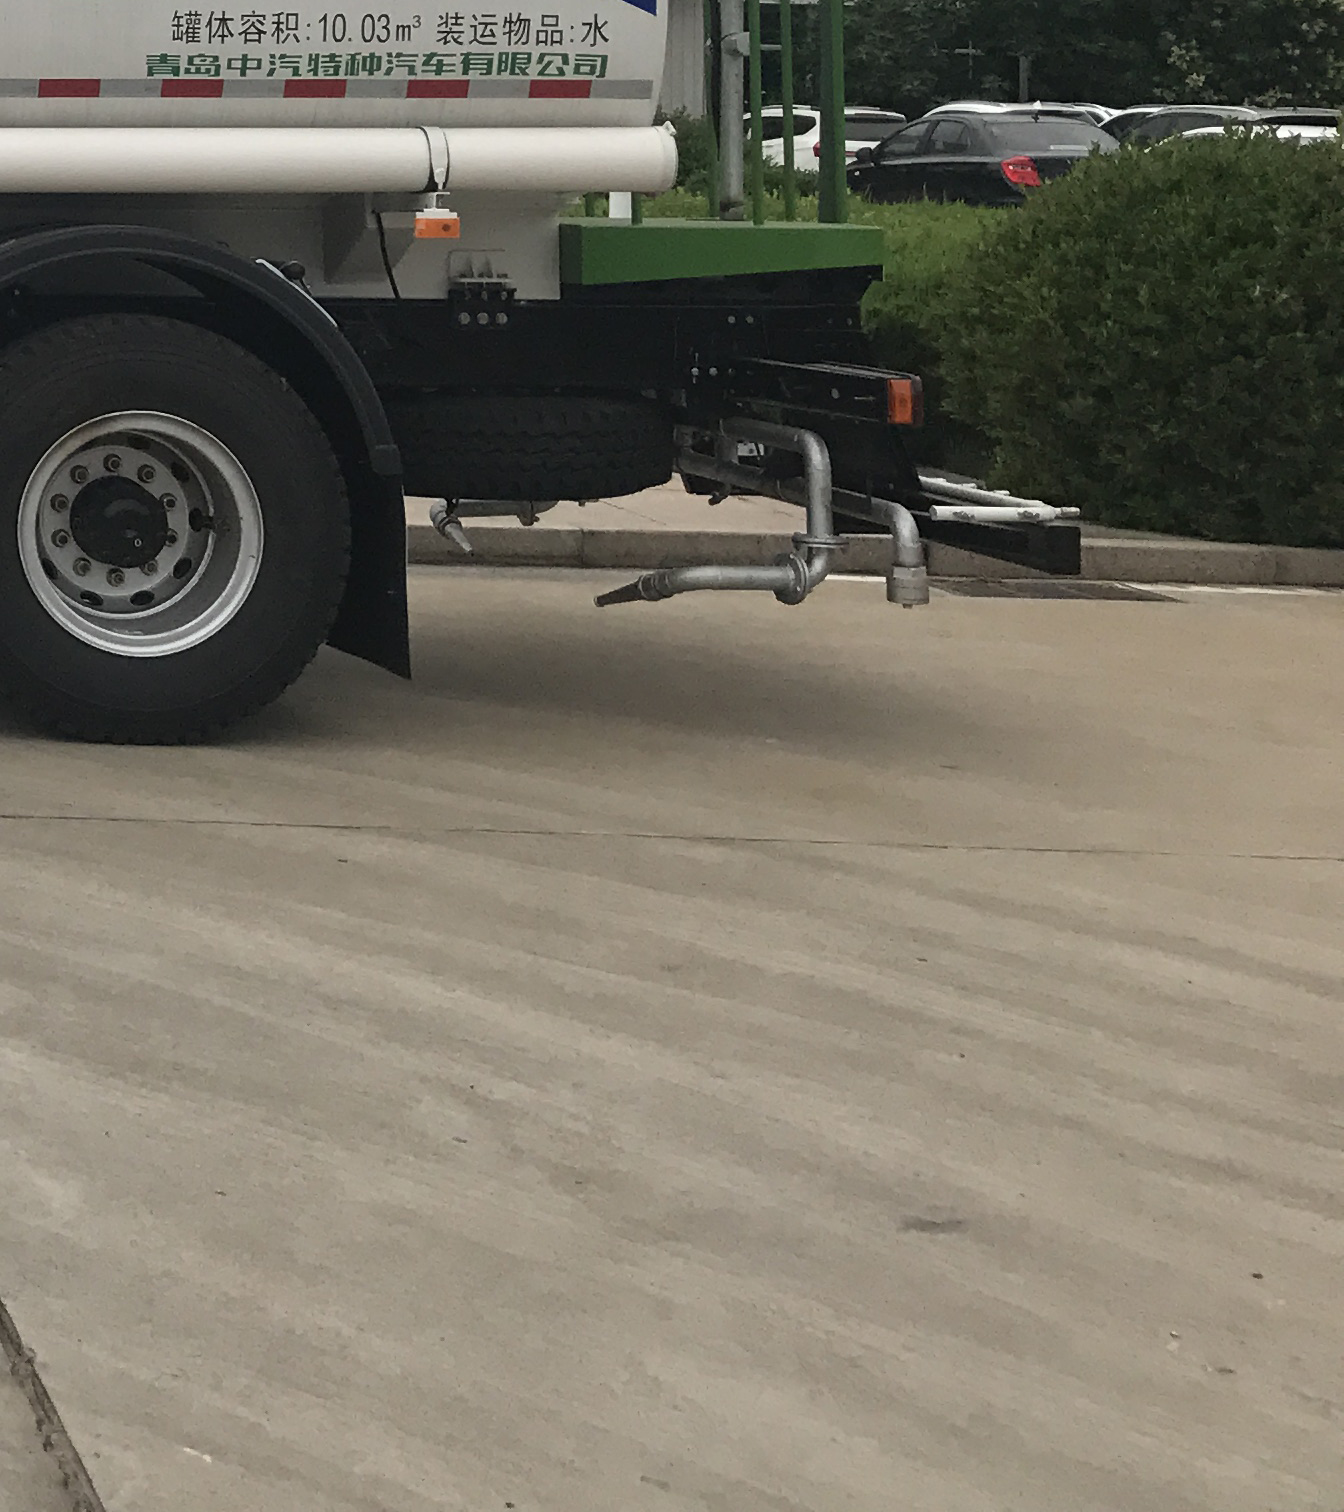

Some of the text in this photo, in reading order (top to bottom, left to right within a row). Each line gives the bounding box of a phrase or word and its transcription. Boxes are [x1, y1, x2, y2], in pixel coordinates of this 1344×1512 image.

[435, 11, 610, 48] 装运物品:水
[145, 51, 609, 79] 青岛中汽特种汽车有限公司
